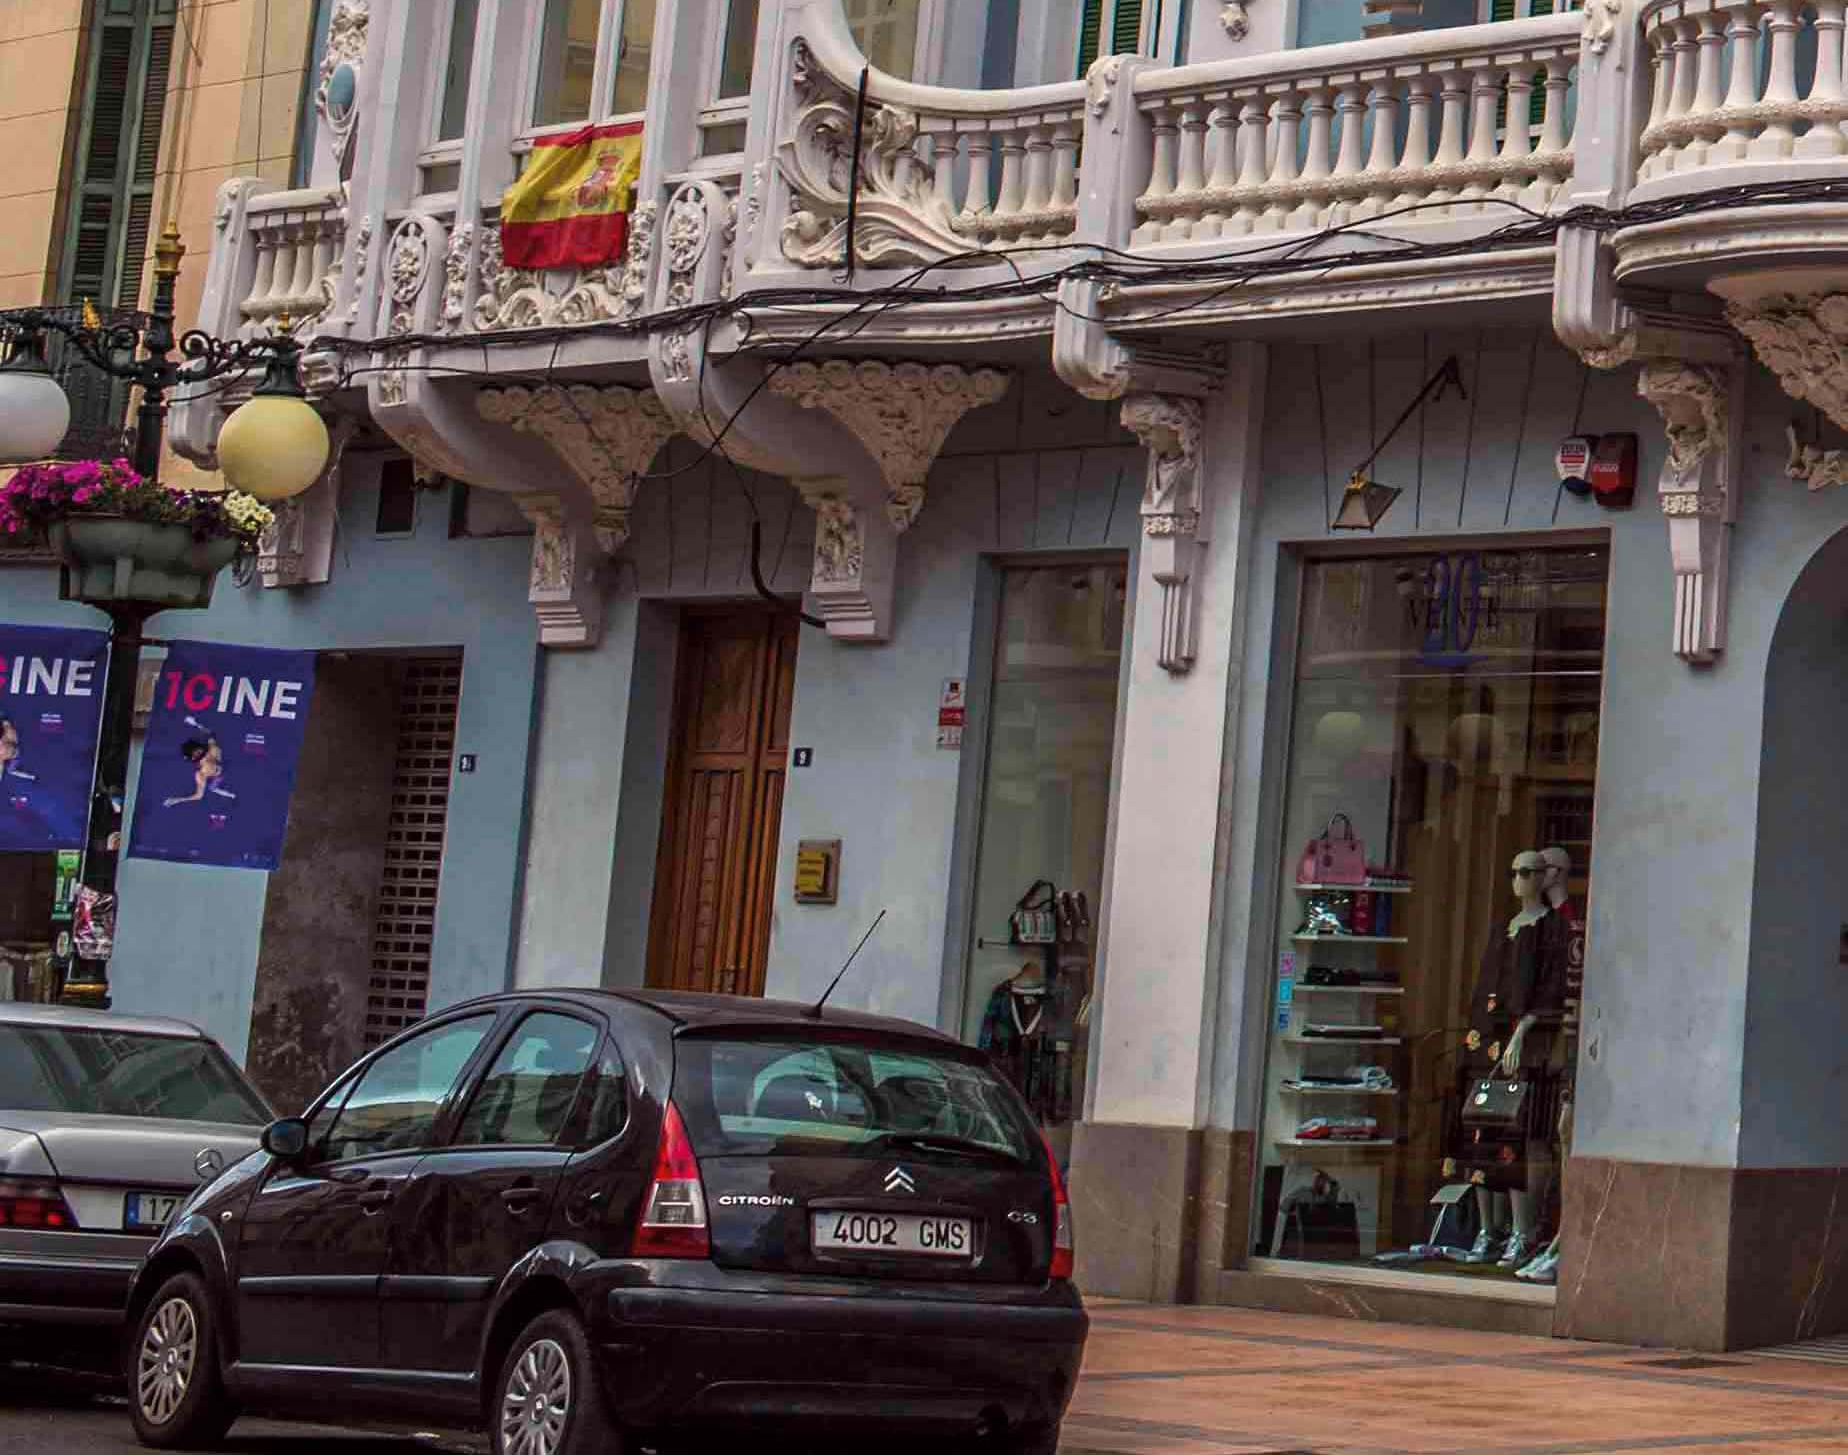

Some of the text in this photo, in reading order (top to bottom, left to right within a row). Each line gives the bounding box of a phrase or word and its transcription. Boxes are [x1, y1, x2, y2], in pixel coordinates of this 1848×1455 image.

[0, 653, 96, 697] INE
[148, 1196, 185, 1223] 17
[833, 1214, 966, 1251] 4002 GMS
